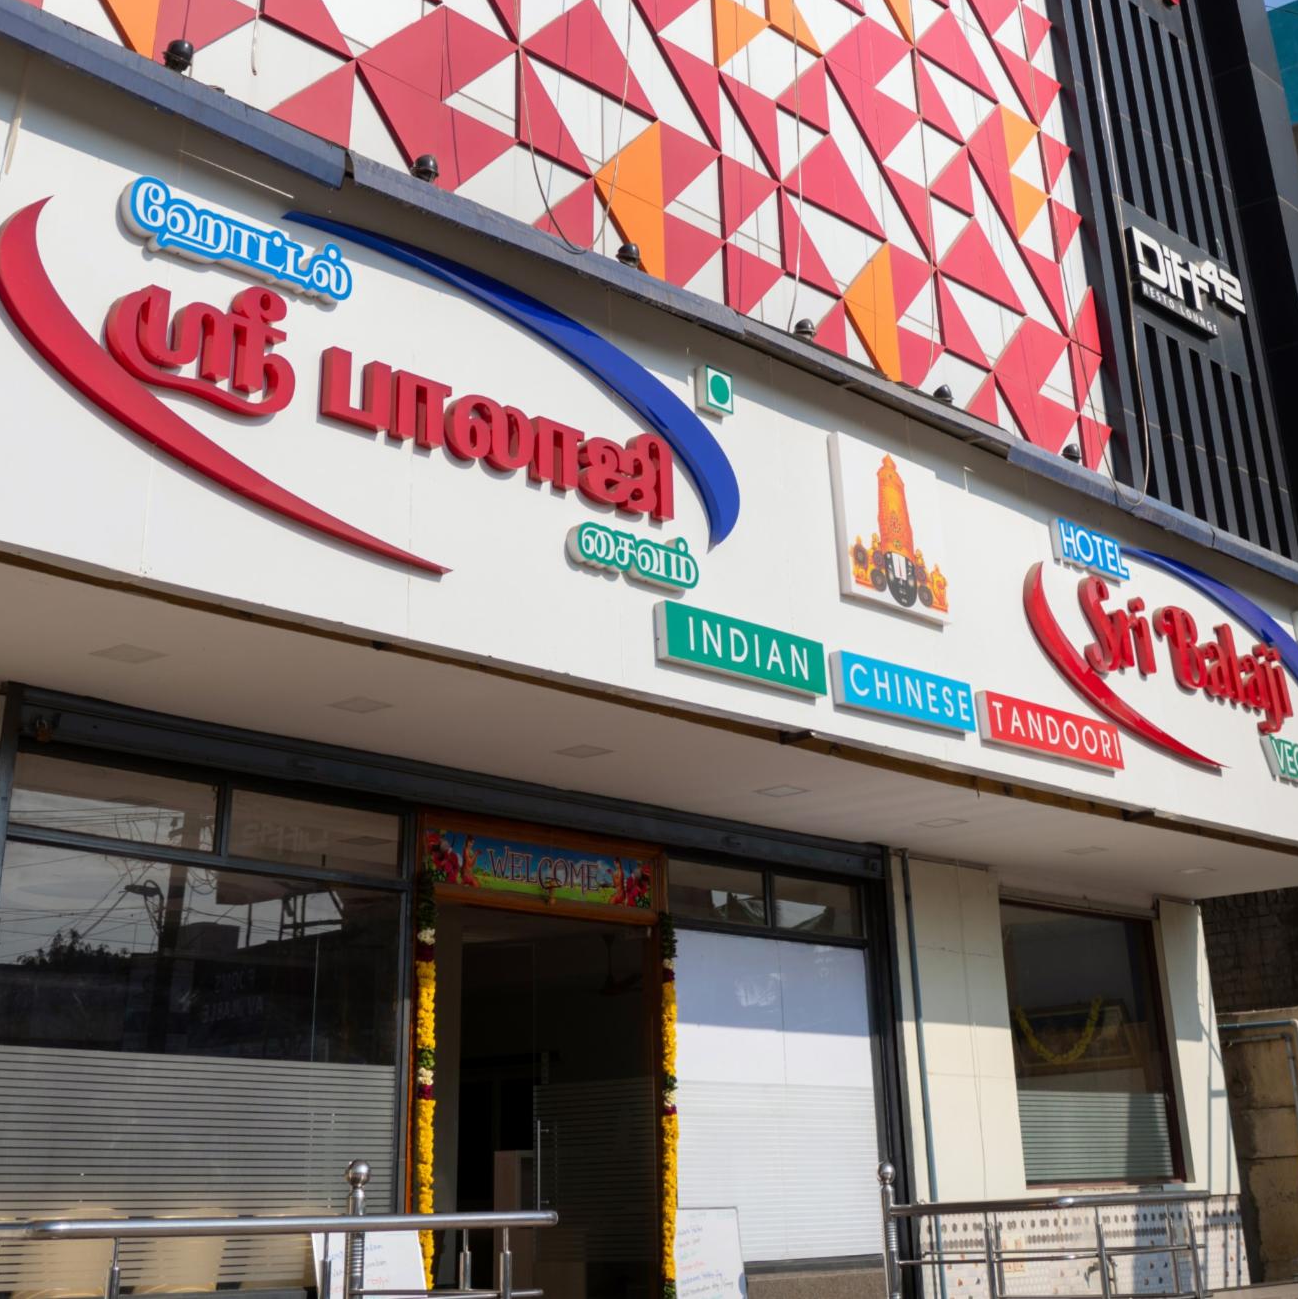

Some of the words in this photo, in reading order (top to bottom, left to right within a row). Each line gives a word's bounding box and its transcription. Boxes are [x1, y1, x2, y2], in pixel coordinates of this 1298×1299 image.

[135, 182, 349, 295] ஹோட்டல்
[1142, 281, 1175, 310] RESTO
[1181, 303, 1219, 335] LOUNGE
[321, 346, 675, 523] பாலாஜி
[581, 524, 697, 584] சைவம்
[1059, 522, 1129, 578] HOTEL
[688, 616, 810, 682] INDIAN
[1077, 575, 1157, 674] Sri
[1153, 605, 1294, 735] Balaji
[849, 662, 971, 723] CHINESE
[992, 700, 1121, 762] TANDOORI
[486, 846, 601, 894] WELCOME
